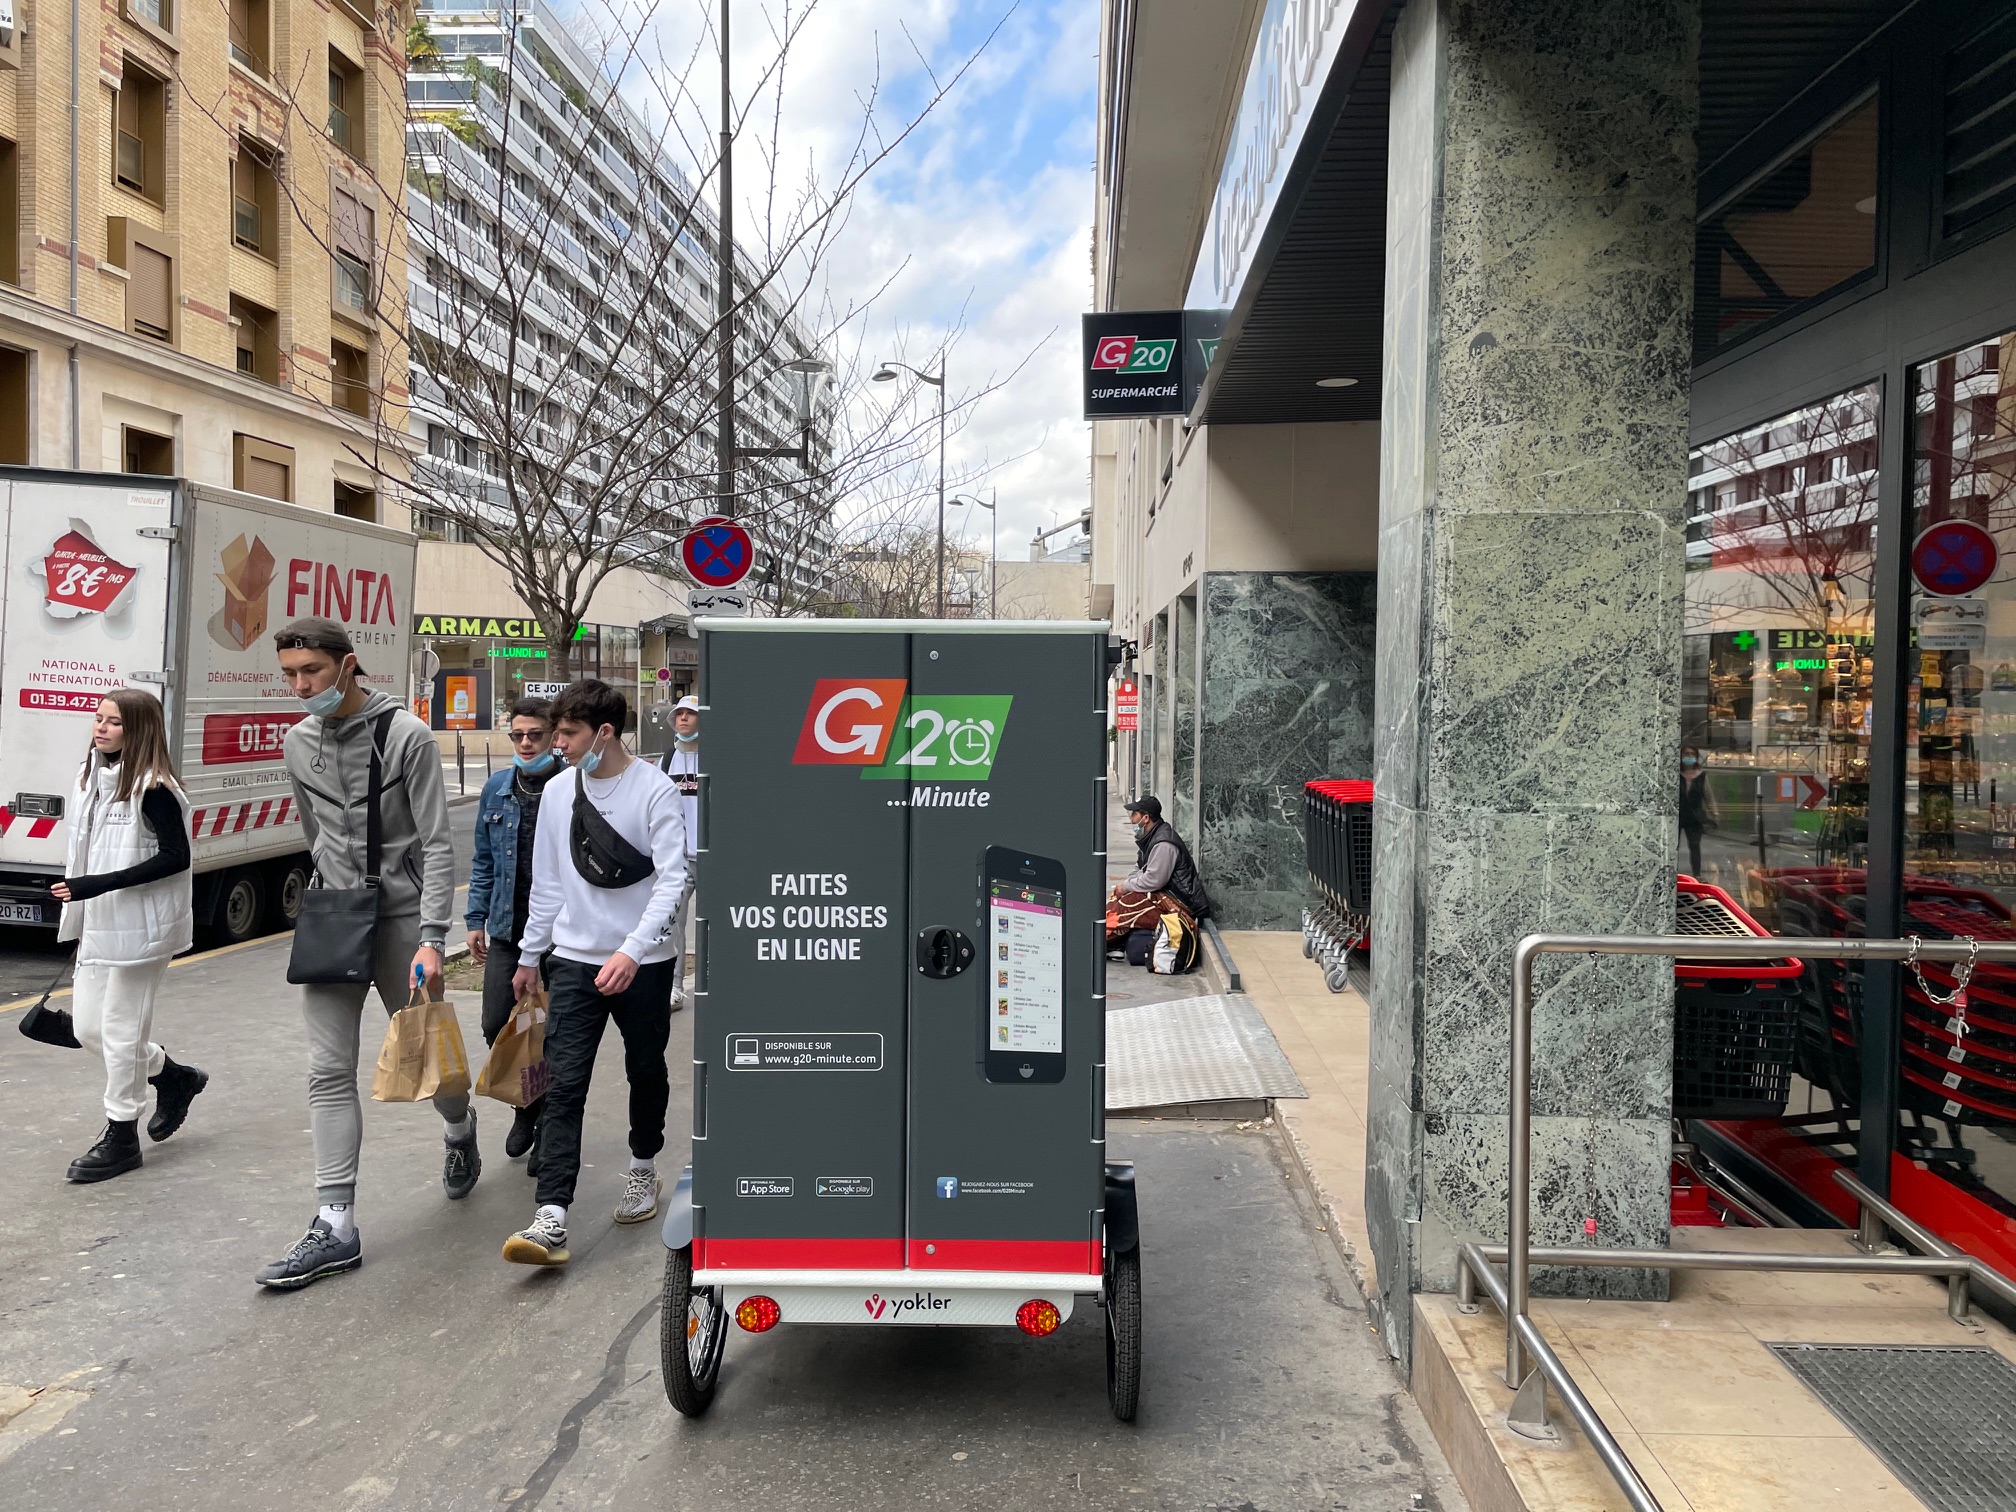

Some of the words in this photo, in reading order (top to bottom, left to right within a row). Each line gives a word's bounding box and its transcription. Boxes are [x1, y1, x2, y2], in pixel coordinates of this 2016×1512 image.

[1101, 341, 1166, 367] G20
[1091, 384, 1178, 398] SUPERMARCHÉ
[56, 563, 108, 597] 8€
[106, 573, 125, 584] /M3
[286, 558, 396, 627] FINTA
[414, 616, 546, 638] ARMACIE
[347, 630, 396, 646] GEMENT
[503, 647, 532, 658] LUNDI
[535, 650, 547, 658] au
[42, 659, 103, 672] NATIONAL
[108, 664, 116, 673] &
[29, 672, 128, 688] INTERNATIONAL
[208, 671, 273, 683] DÉMÉNAGEMENT
[527, 684, 541, 693] CE
[544, 684, 568, 693] JOU
[30, 693, 102, 709] 01.39.47.3
[239, 722, 291, 753] 01.39
[222, 776, 249, 789] EMAIL
[256, 771, 292, 785] FINTA.DE
[771, 874, 848, 896] FAITES
[730, 906, 776, 928] VOS
[782, 905, 888, 929] COURSES
[757, 938, 787, 961] EN
[794, 938, 861, 961] LIGNE
[765, 1042, 813, 1050] DISPONIBLE
[815, 1042, 832, 1050] SUR
[765, 1054, 876, 1066] www.g20-minute.com
[750, 1185, 767, 1195] App
[769, 1185, 790, 1193] Store
[829, 1185, 855, 1194] Google
[856, 1185, 870, 1194] play
[891, 1292, 952, 1319] yokler
